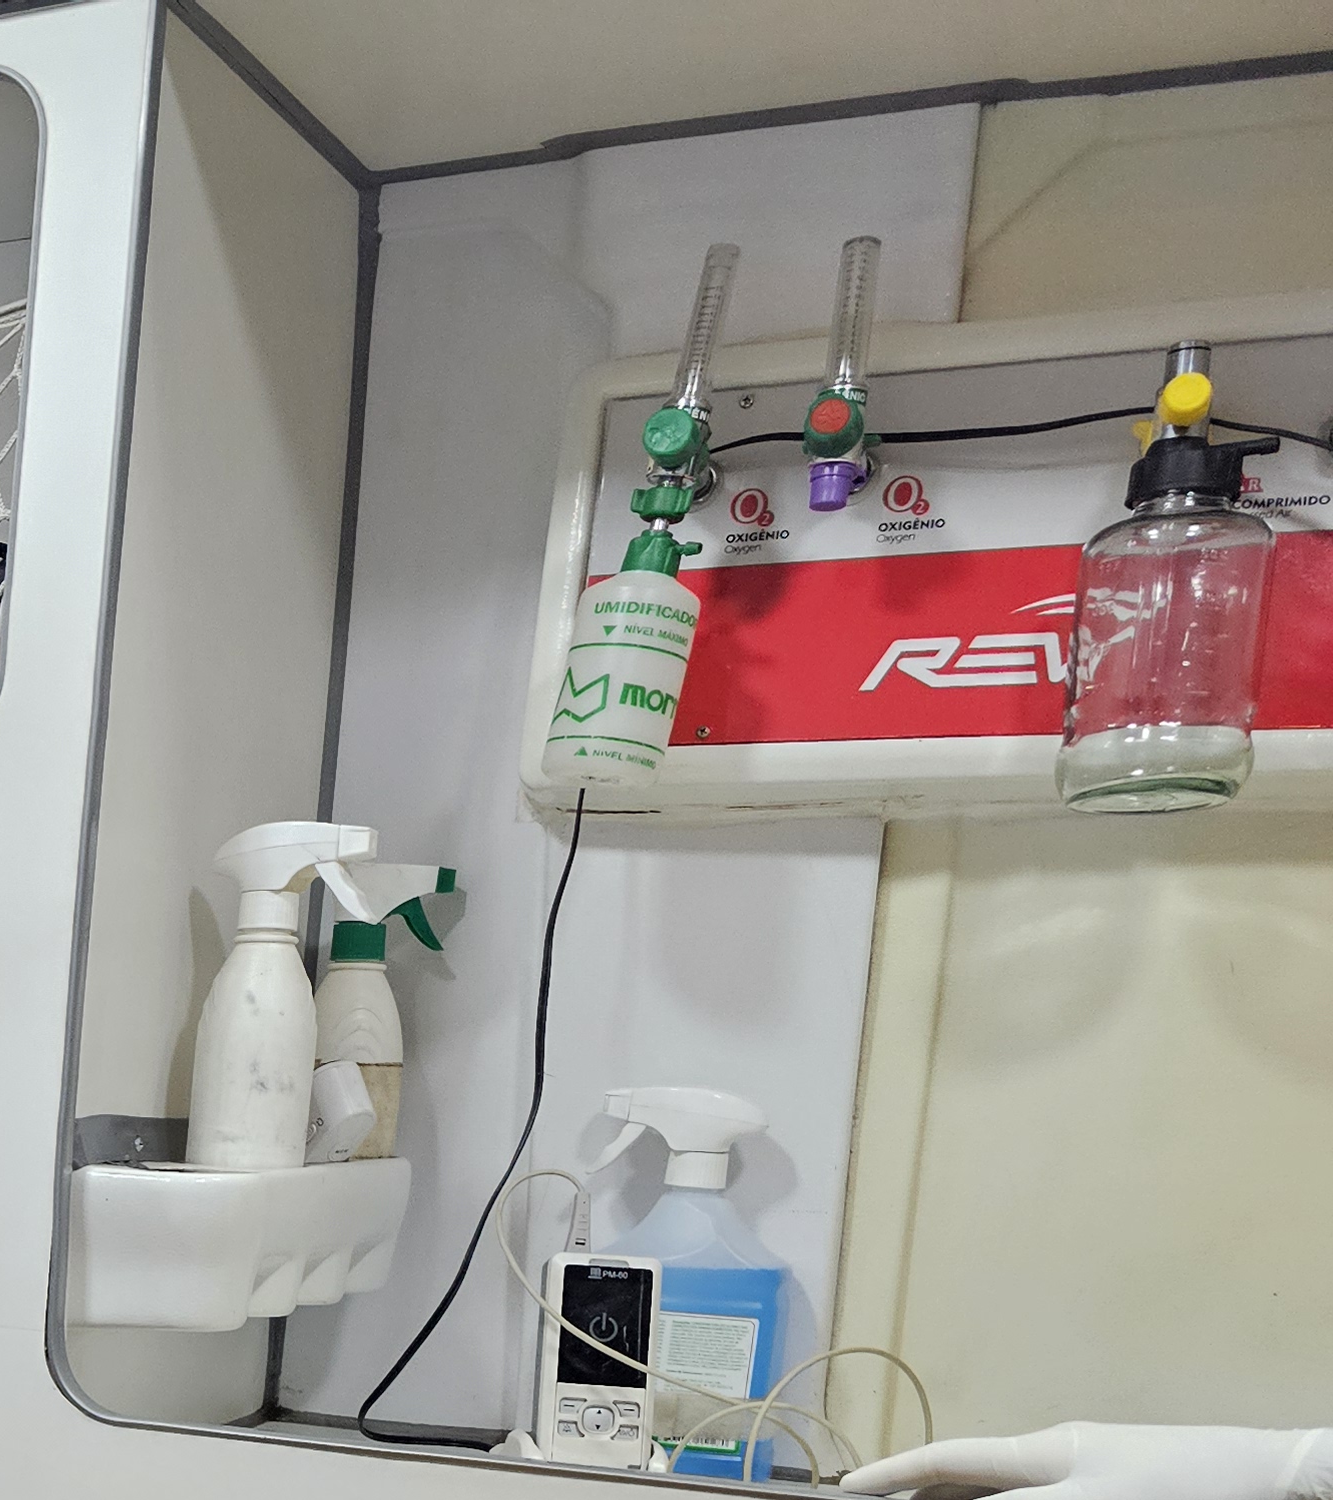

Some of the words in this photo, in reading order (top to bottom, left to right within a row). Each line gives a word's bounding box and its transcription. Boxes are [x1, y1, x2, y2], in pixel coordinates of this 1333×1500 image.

[1232, 495, 1331, 510] COMPRIMIDO
[878, 517, 946, 532] OXIGÊNIO
[725, 528, 790, 543] OXIGÊNIO
[876, 533, 916, 545] Oxygen
[724, 544, 762, 556] Oxygen
[594, 601, 698, 629] UMIDIFICADO
